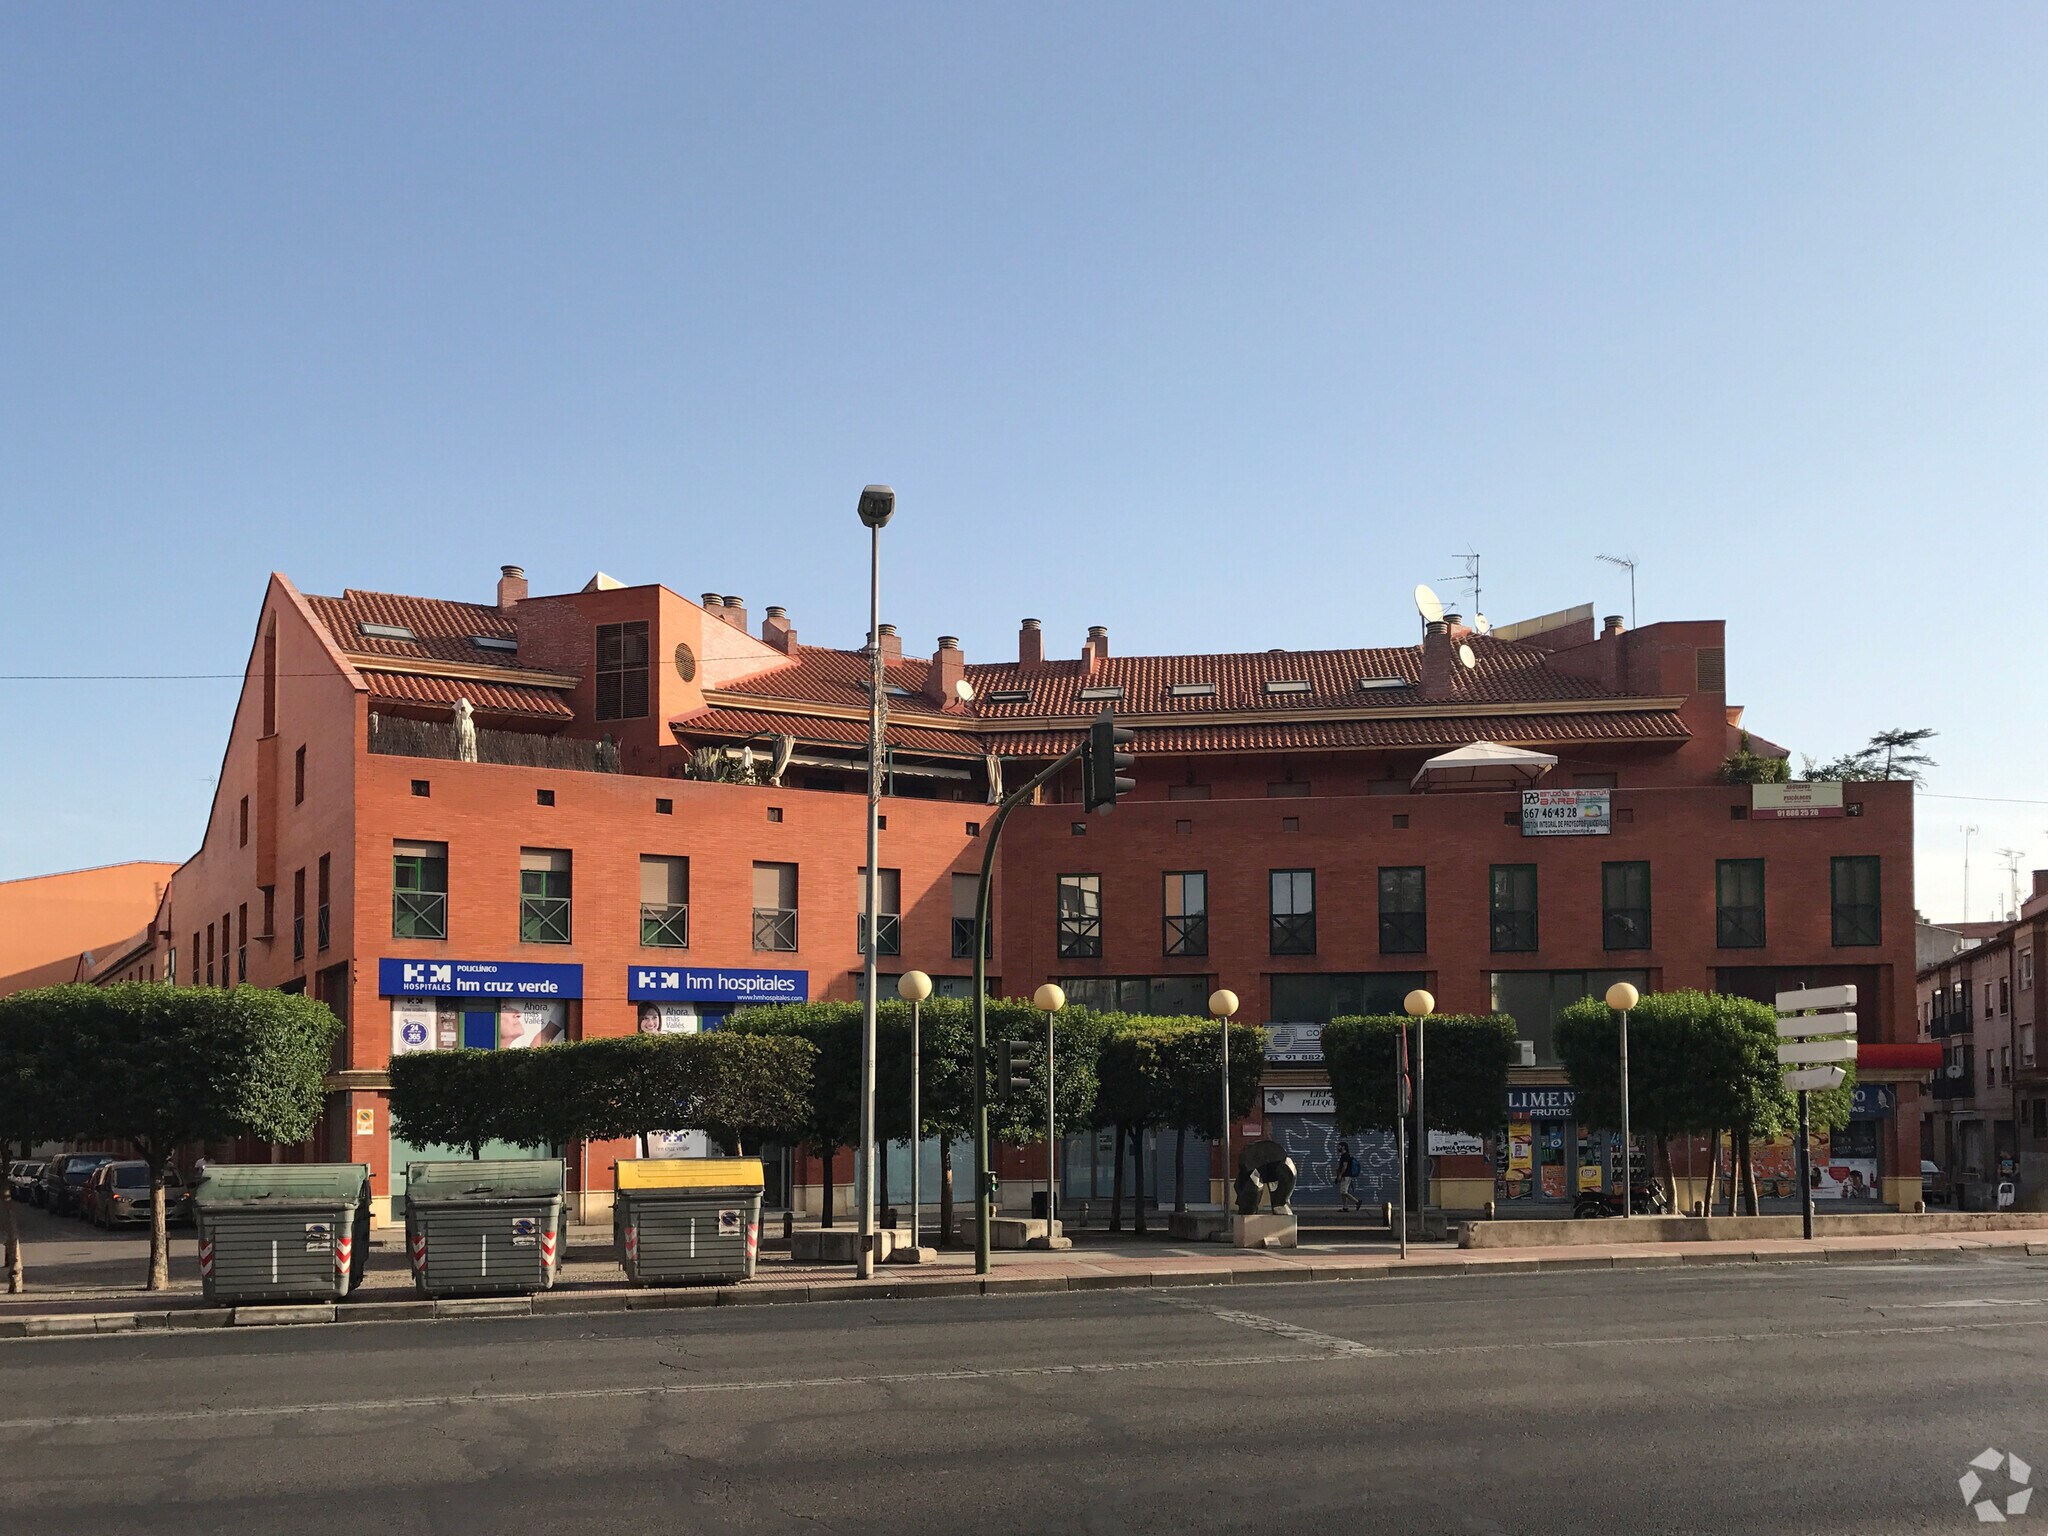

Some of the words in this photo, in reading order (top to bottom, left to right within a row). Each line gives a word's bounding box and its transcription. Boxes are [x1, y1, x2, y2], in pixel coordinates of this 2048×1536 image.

[1524, 808, 1539, 818] 667
[1542, 807, 1553, 818] 46
[1554, 807, 1565, 818] 43
[1567, 807, 1577, 818] 28
[456, 964, 498, 973] POLICLÍNICO
[403, 983, 452, 991] HOSPITALES
[456, 977, 480, 992] hm
[483, 981, 514, 992] cruz
[517, 980, 559, 993] verde
[686, 972, 713, 990] hm
[718, 973, 796, 994] hospitales
[736, 994, 804, 1002] www.hmhospitales.com
[523, 1001, 550, 1012] Ahora,
[665, 1007, 690, 1016] Ahora,
[1530, 1108, 1572, 1116] FRUTOS
